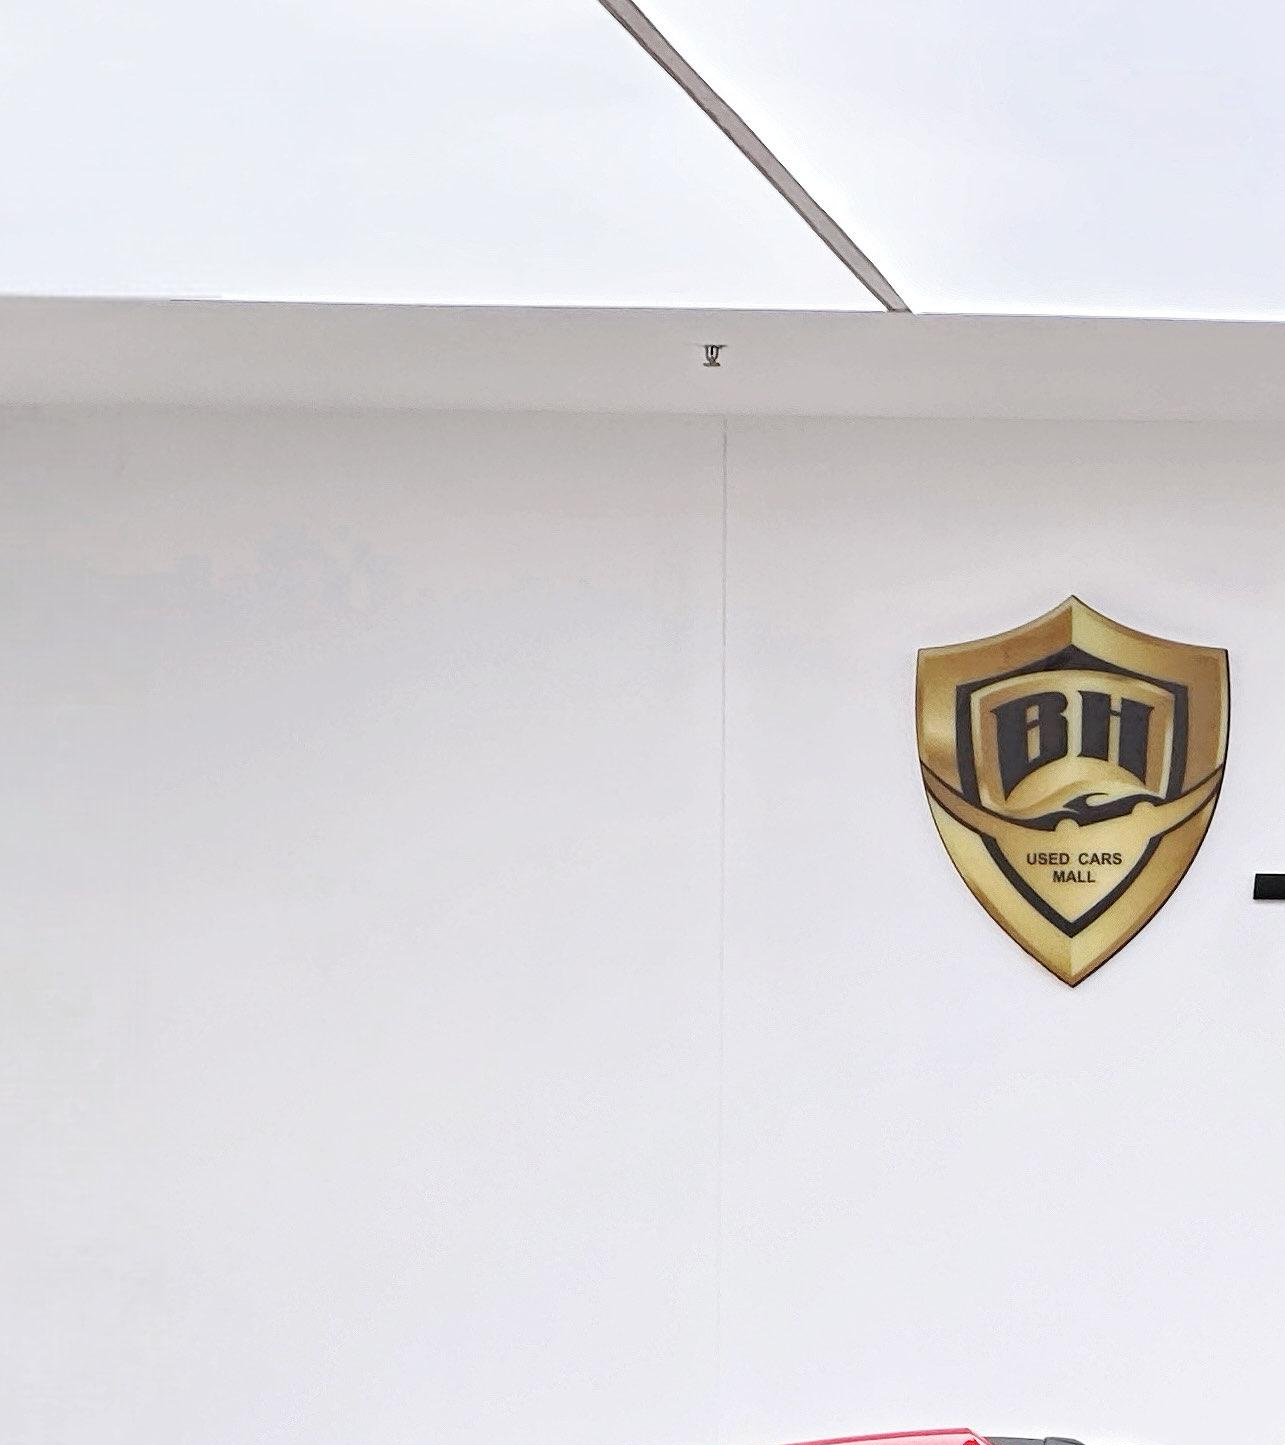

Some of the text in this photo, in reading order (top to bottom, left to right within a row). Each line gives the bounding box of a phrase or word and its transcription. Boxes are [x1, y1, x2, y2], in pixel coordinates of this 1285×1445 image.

[990, 689, 1155, 801] BH
[1026, 852, 1123, 866] USED CARS
[1052, 870, 1096, 884] MALL
